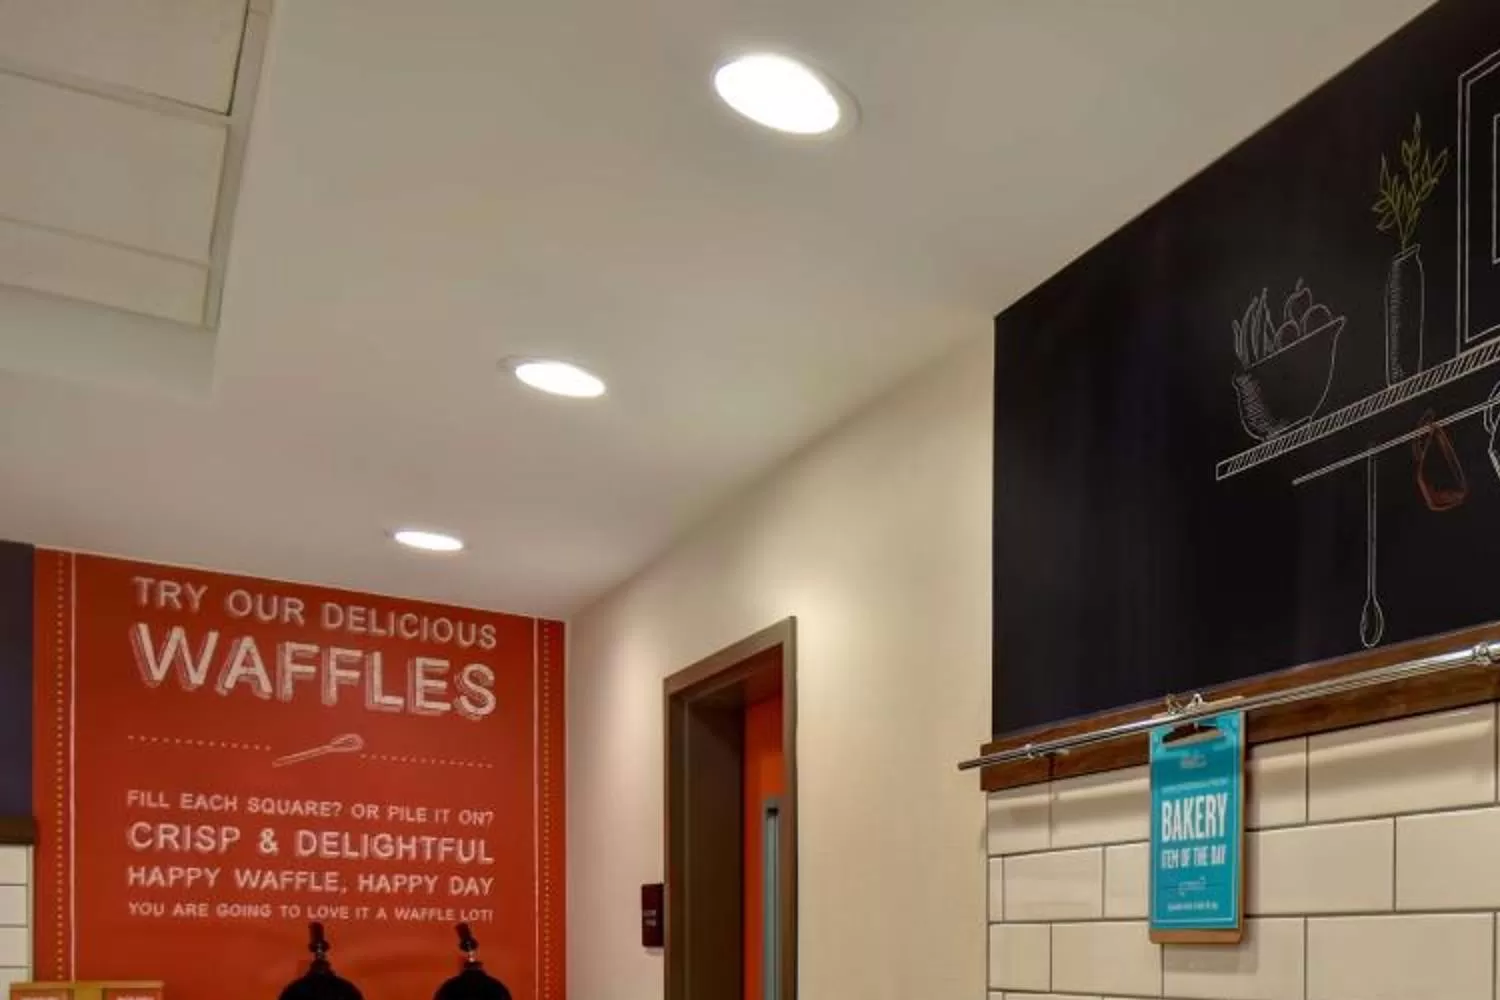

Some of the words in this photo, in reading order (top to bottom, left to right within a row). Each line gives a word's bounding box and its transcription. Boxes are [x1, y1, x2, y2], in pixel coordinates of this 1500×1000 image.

[132, 576, 208, 612] TRY
[226, 589, 306, 626] OUR
[321, 602, 497, 650] DELICIOUS
[129, 621, 498, 721] WAFFLES
[126, 789, 170, 810] FILL
[179, 793, 238, 812] EACH
[247, 797, 343, 818] SQUARE?
[351, 803, 380, 821] OR
[387, 805, 427, 823] PILE
[435, 808, 450, 824] IT
[458, 809, 495, 826] ON?
[1161, 792, 1228, 842] BAKERY
[126, 821, 241, 853] CRISP
[259, 827, 279, 855] &
[294, 828, 495, 865] DELIGHTFUL
[126, 865, 221, 888] HAPPY
[234, 867, 348, 894] WAFFLE,
[357, 872, 439, 895] HAPPY
[448, 875, 495, 896] DAY
[128, 902, 165, 917] YOU
[172, 903, 209, 918] ARE
[215, 903, 272, 919] GOING
[279, 905, 300, 919] TO
[306, 905, 349, 920] LOVE
[355, 907, 369, 920] IT
[375, 908, 387, 921] A
[394, 907, 456, 921] WAFFLE
